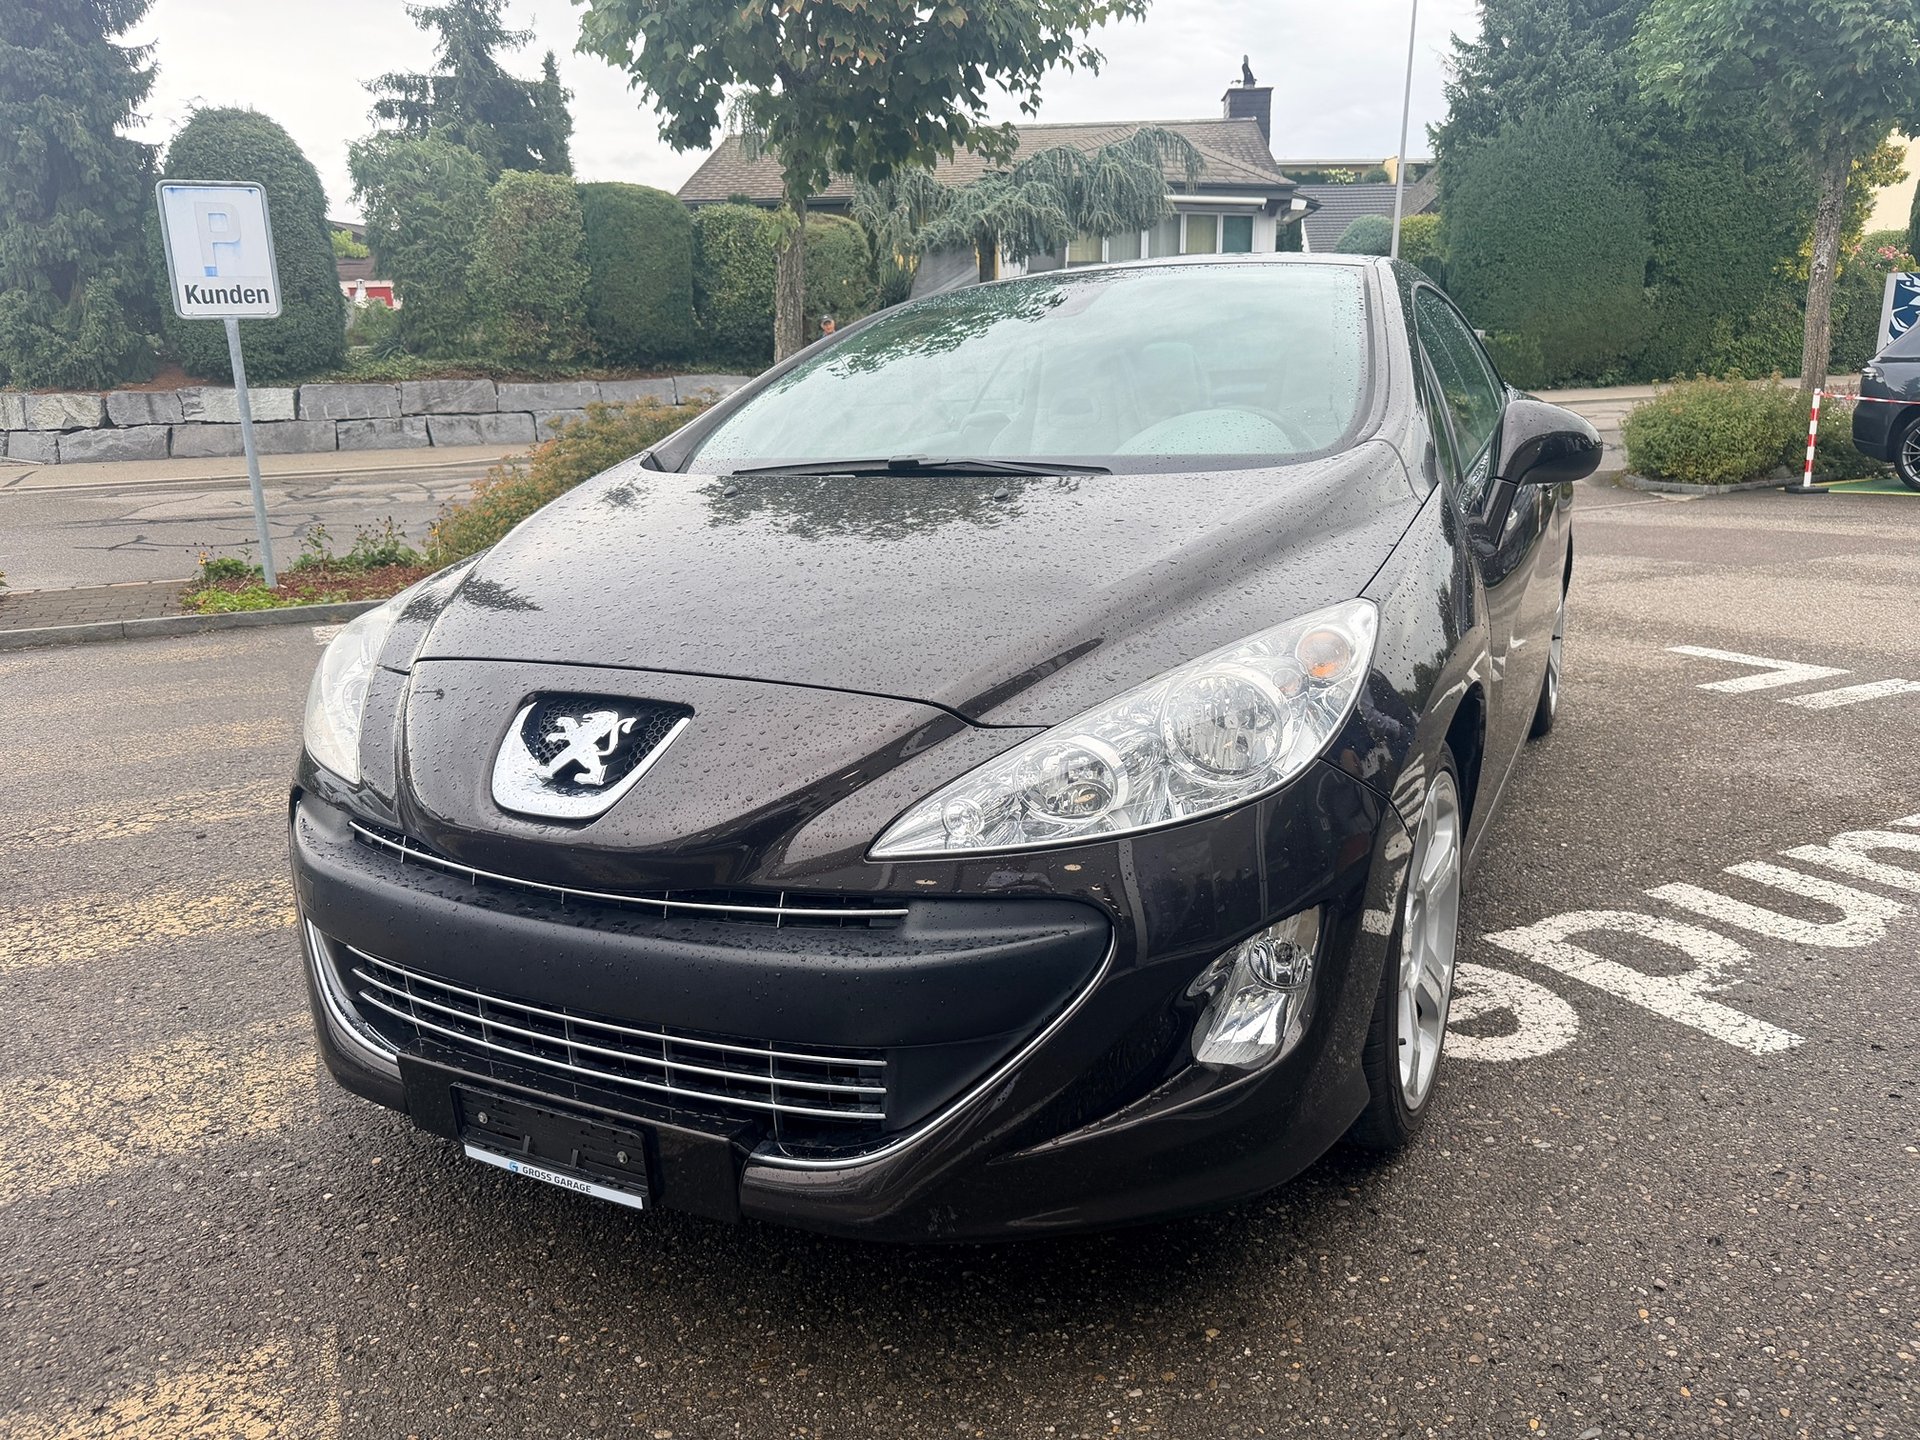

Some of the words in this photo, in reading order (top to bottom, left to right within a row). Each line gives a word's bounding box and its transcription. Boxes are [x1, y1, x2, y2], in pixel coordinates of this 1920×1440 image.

[194, 201, 241, 268] P
[184, 284, 270, 304] Kunden
[522, 1166, 552, 1182] GROSS
[554, 1175, 592, 1194] GARAGE
